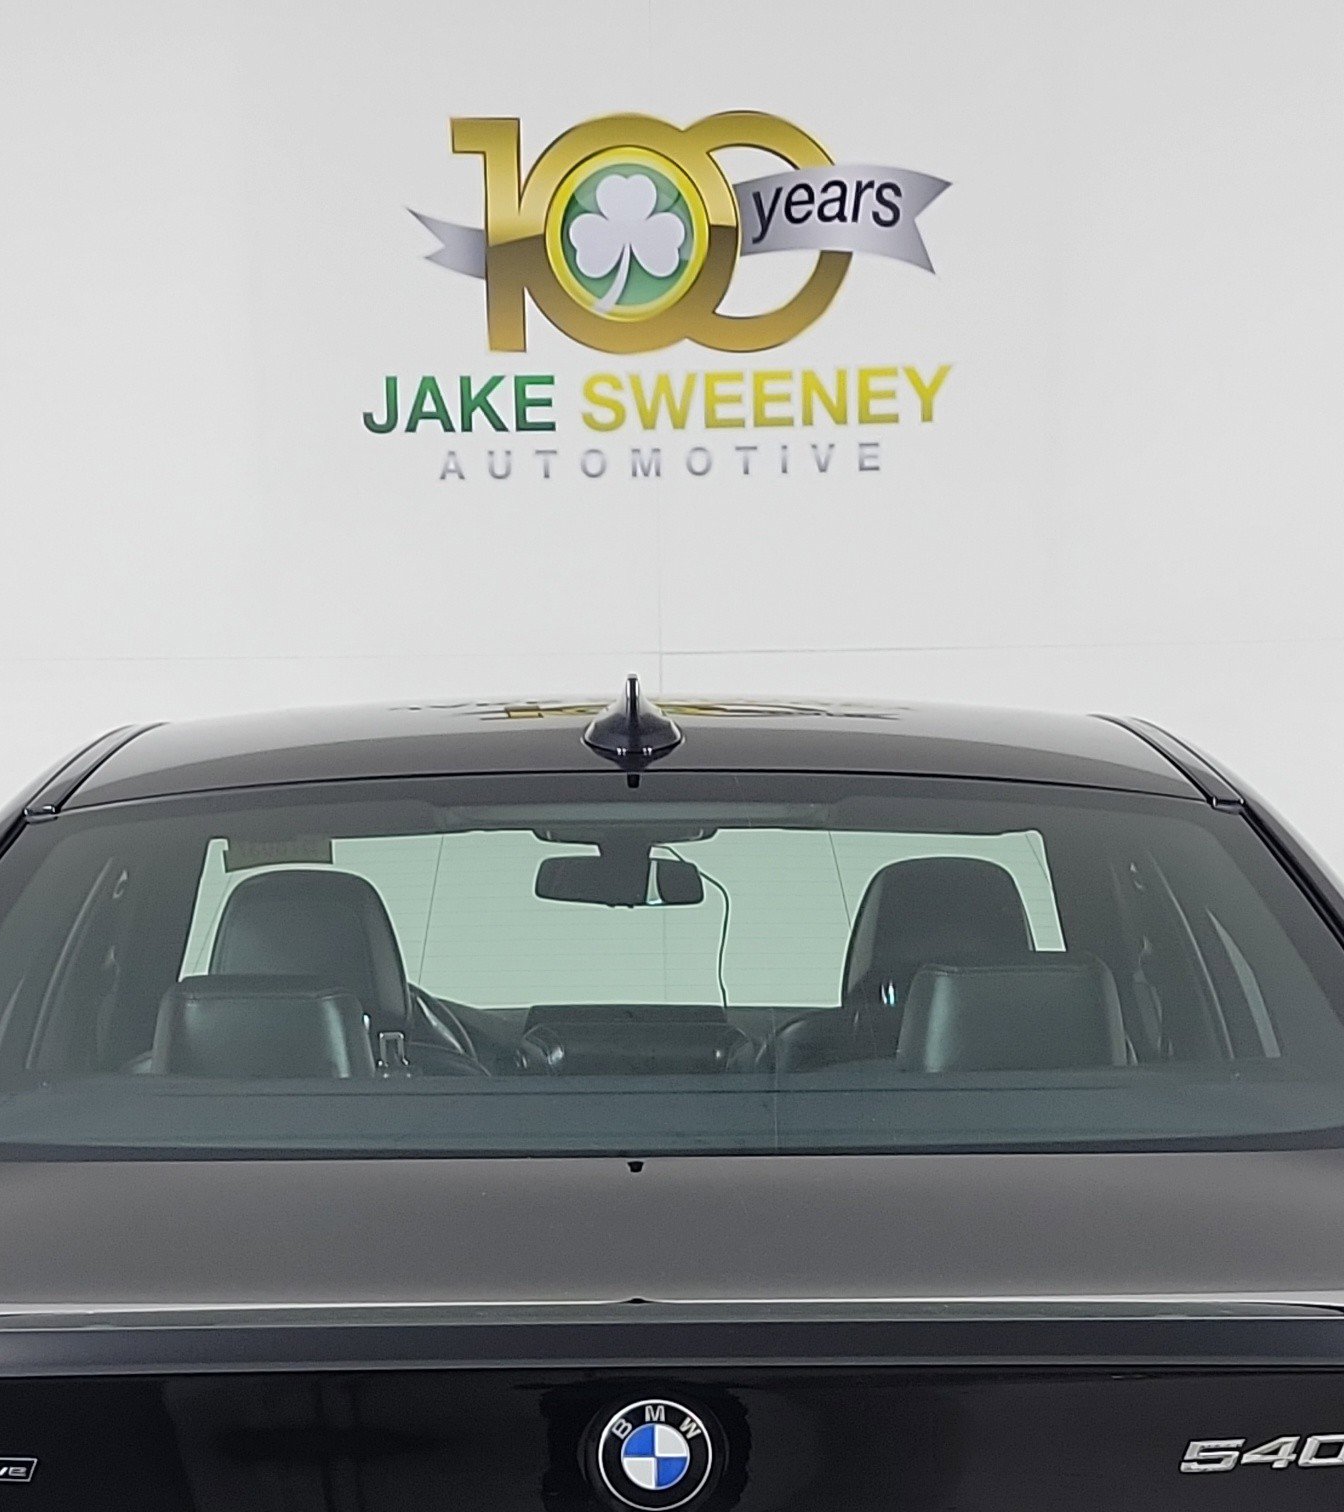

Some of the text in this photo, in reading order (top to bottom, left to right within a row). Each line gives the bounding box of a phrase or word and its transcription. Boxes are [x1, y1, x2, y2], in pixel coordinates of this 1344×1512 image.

[450, 109, 853, 355] 100
[751, 179, 903, 244] years
[362, 364, 952, 434] JAKE SWEENEY
[438, 442, 881, 481] AUTOMOTIVE
[612, 1405, 702, 1440] BMW
